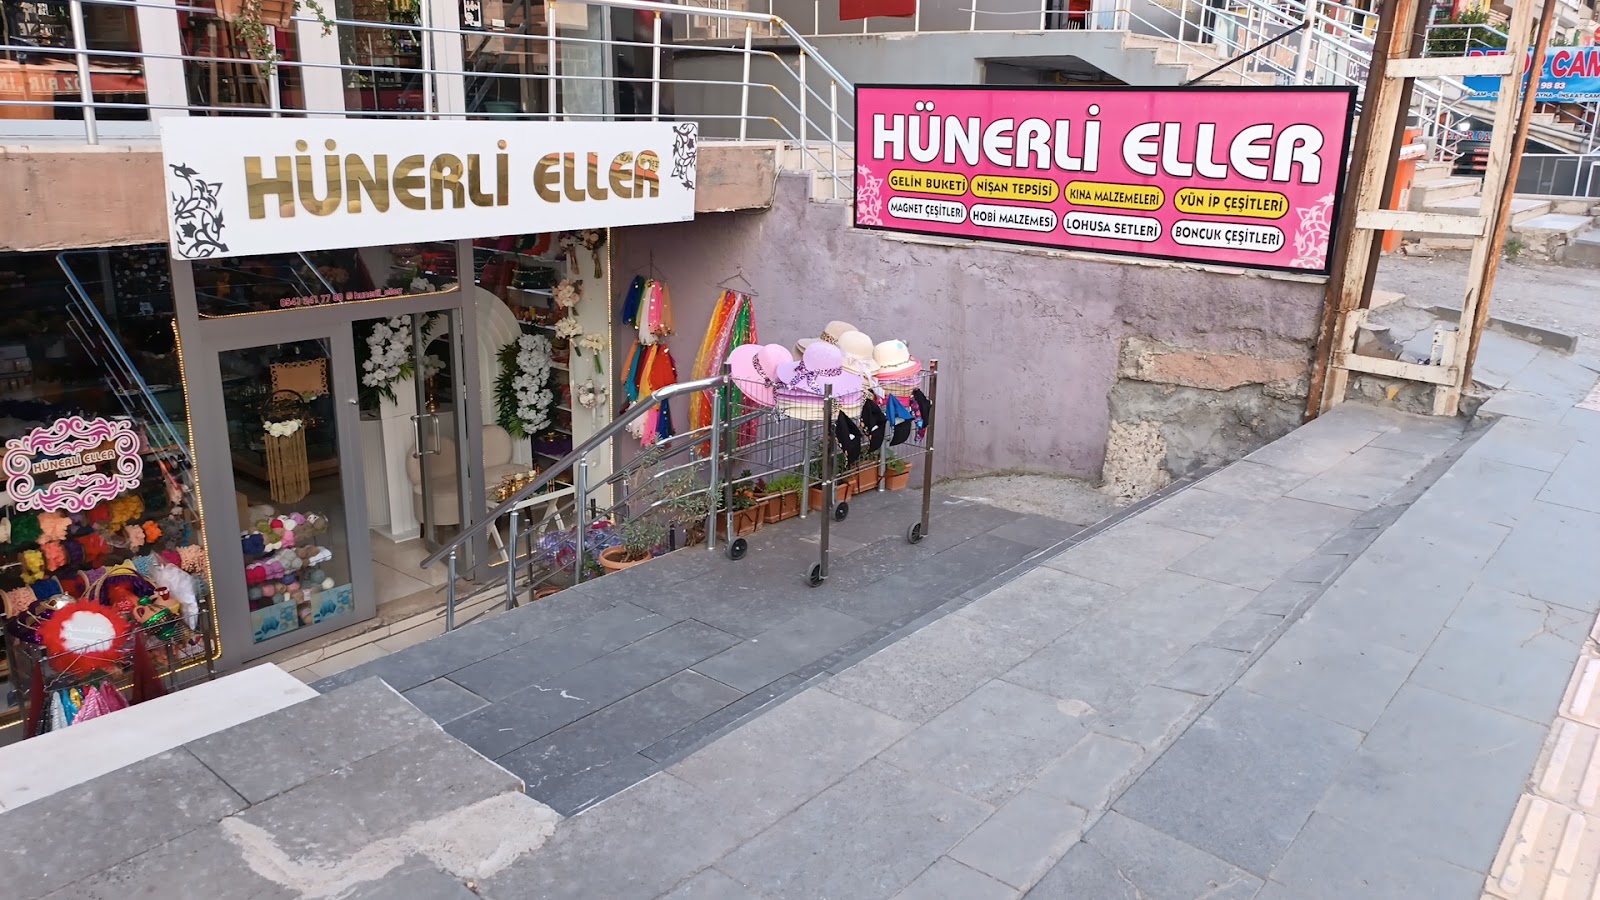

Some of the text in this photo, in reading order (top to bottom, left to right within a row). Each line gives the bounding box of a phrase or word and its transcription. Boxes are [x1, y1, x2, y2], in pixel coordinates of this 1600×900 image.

[1552, 50, 1600, 77] CAM
[872, 100, 1324, 184] HÜNERLİ ELLER
[243, 138, 659, 219] HÜNERLİ ELLER
[891, 174, 966, 191] GELİN BUKETİ
[977, 181, 1052, 196] NİŞAN TEPSİSİ
[1070, 188, 1159, 205] KINA MALZEMELERİ
[891, 203, 963, 218] MAGNET ÇEŞİTLERİ
[1180, 192, 1282, 212] YÜN İP ÇEŞİTLERİ
[973, 209, 1053, 227] HOBİ MALZEMESİ
[1066, 219, 1157, 237] LOHUSA SETLERİ
[1176, 226, 1279, 245] BONCUK ÇEŞİTLERİ
[321, 293, 331, 302] 77
[33, 453, 82, 473] HÜNERLİ
[83, 449, 115, 463] ELLER
